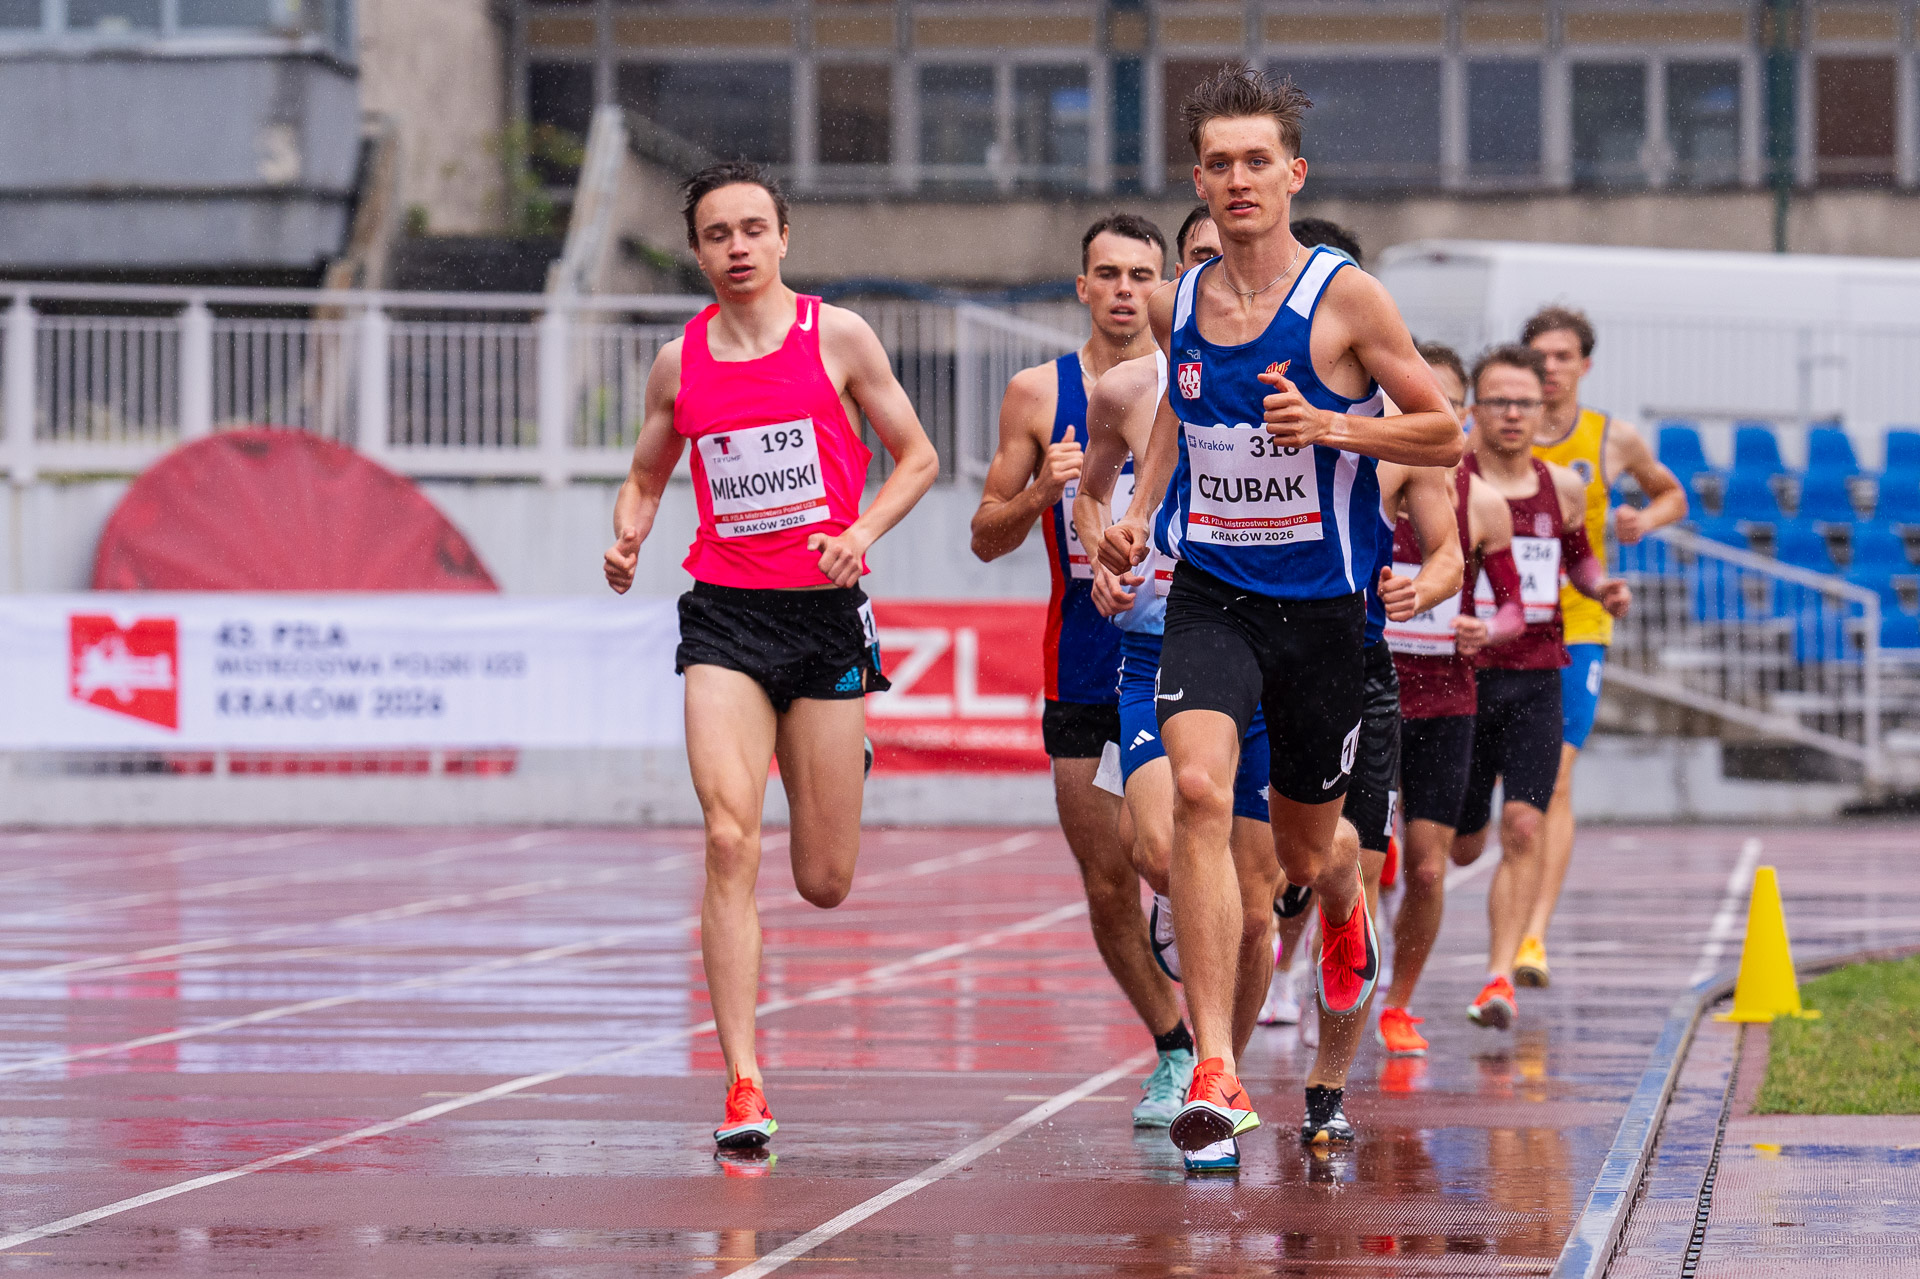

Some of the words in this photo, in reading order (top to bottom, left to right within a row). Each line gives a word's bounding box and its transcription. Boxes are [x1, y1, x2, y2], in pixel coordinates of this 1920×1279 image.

[761, 429, 804, 453] 193
[1198, 439, 1234, 451] Kraków
[711, 464, 817, 501] MIŁKOWSKI
[1198, 474, 1307, 503] CZUBAK
[733, 520, 777, 534] KRAKÓW
[780, 515, 806, 527] 2026
[1200, 516, 1210, 524] 43.
[1224, 520, 1268, 528] Mistrzostwa
[1269, 519, 1292, 527] Polski
[1292, 515, 1308, 524] U23
[1211, 530, 1262, 543] KRAKÓW
[1265, 530, 1294, 541] 2026
[216, 685, 359, 719] KRAKÓW
[372, 688, 443, 717] 2026
